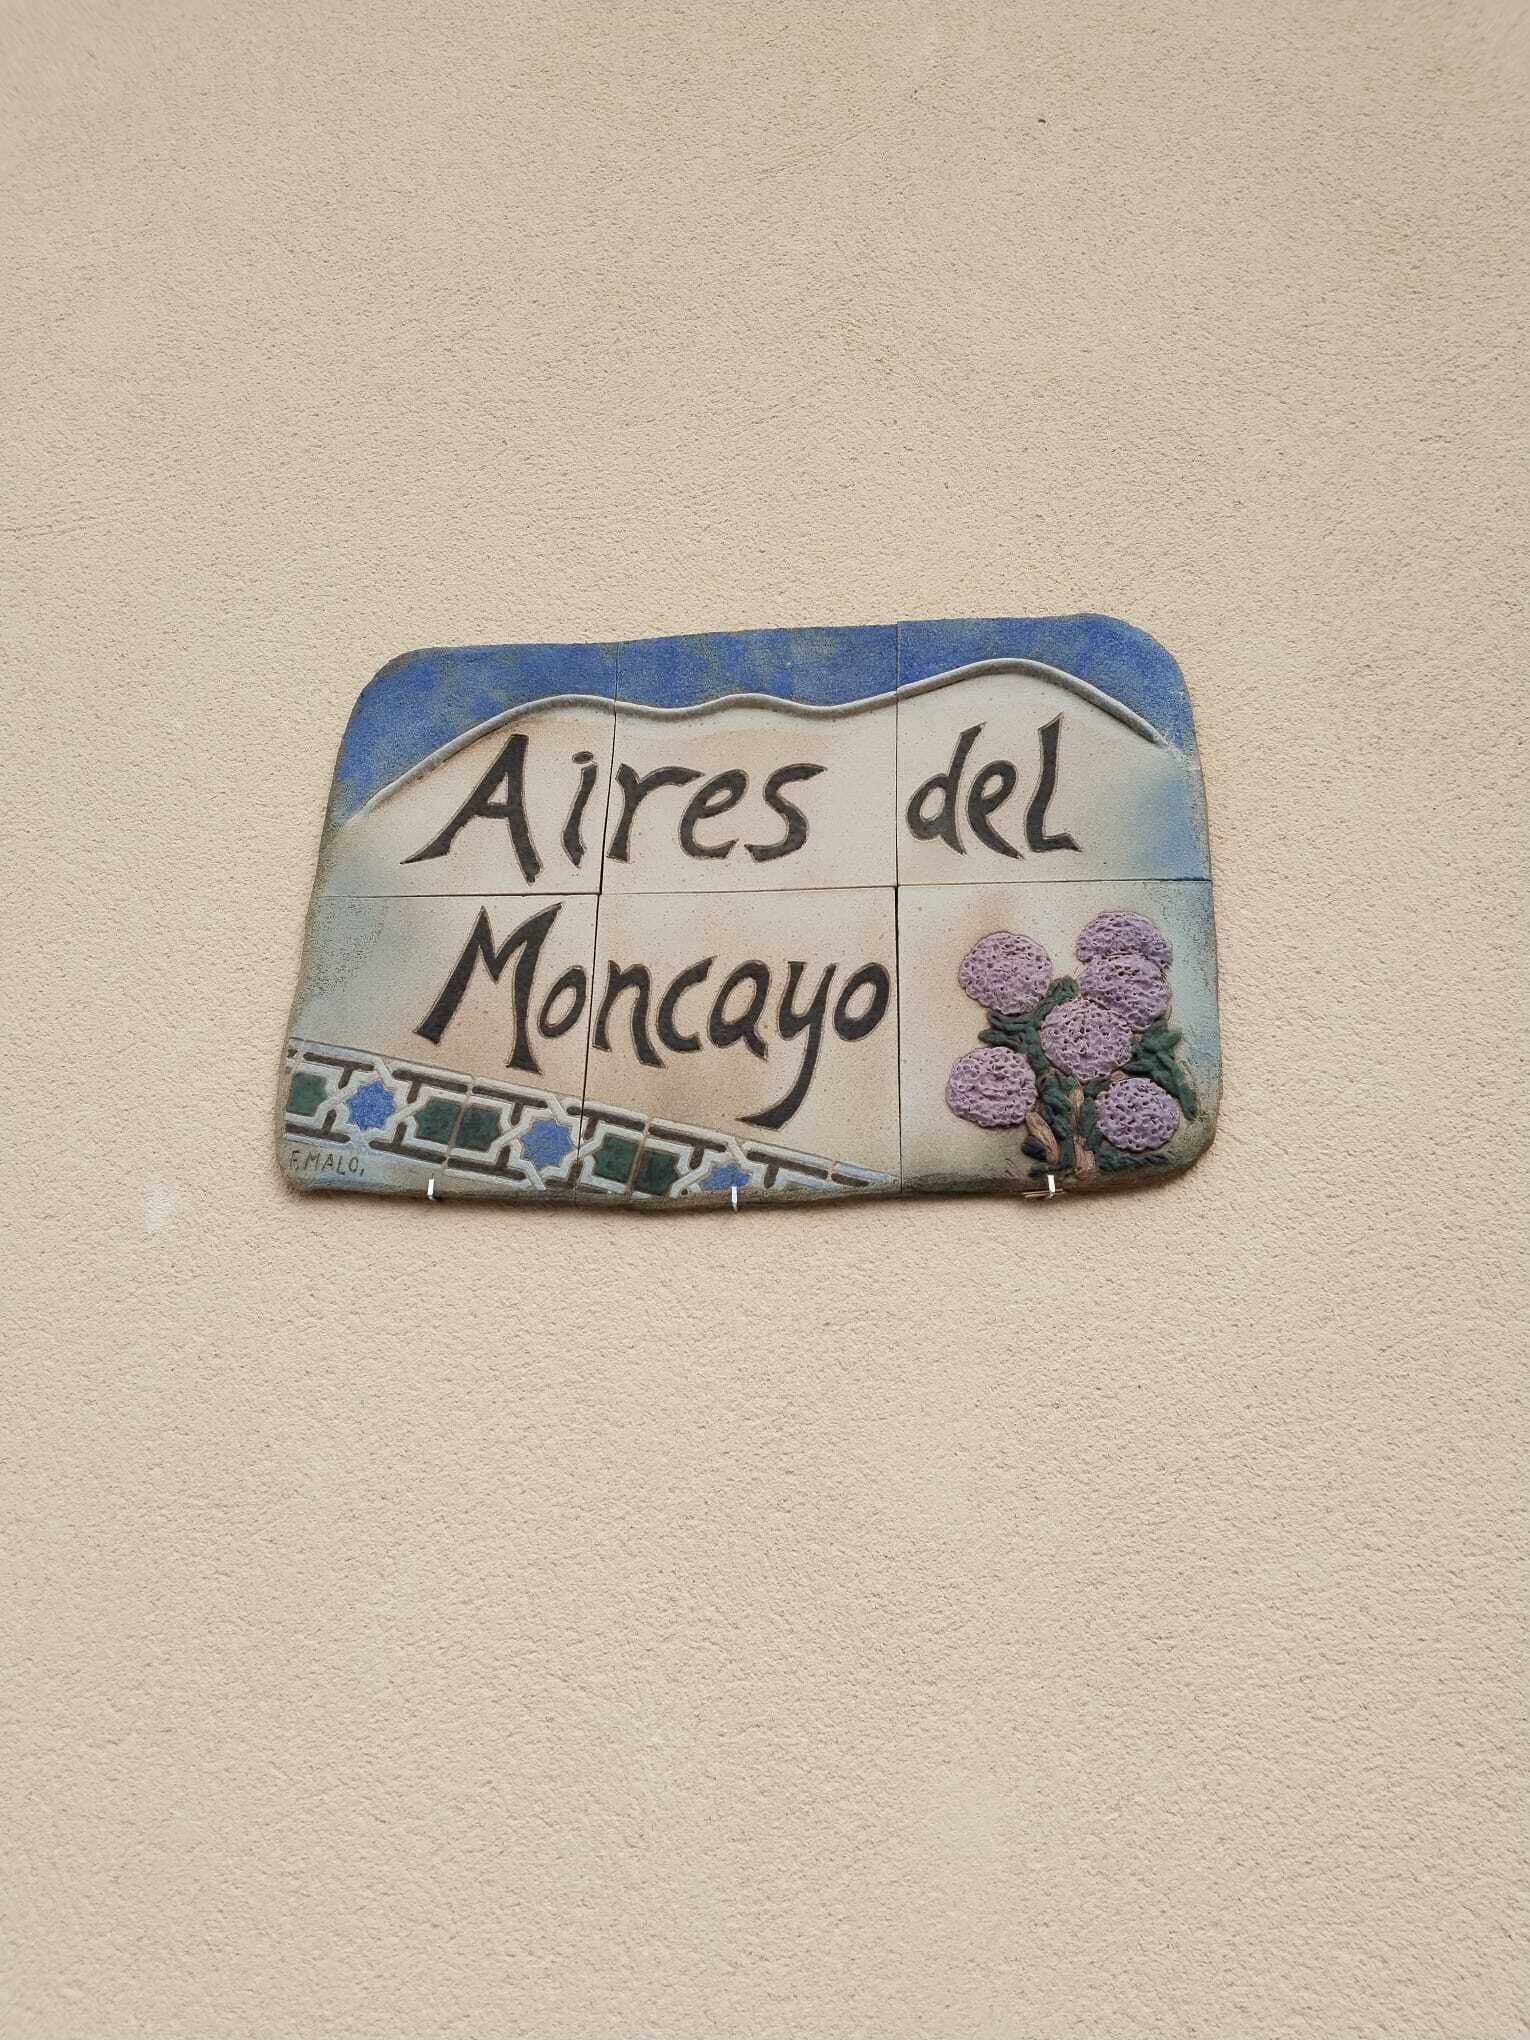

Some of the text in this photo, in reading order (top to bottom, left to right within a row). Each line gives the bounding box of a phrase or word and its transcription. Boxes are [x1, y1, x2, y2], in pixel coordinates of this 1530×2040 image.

[401, 713, 1082, 885] Aires del
[414, 902, 892, 1130] Moncayo
